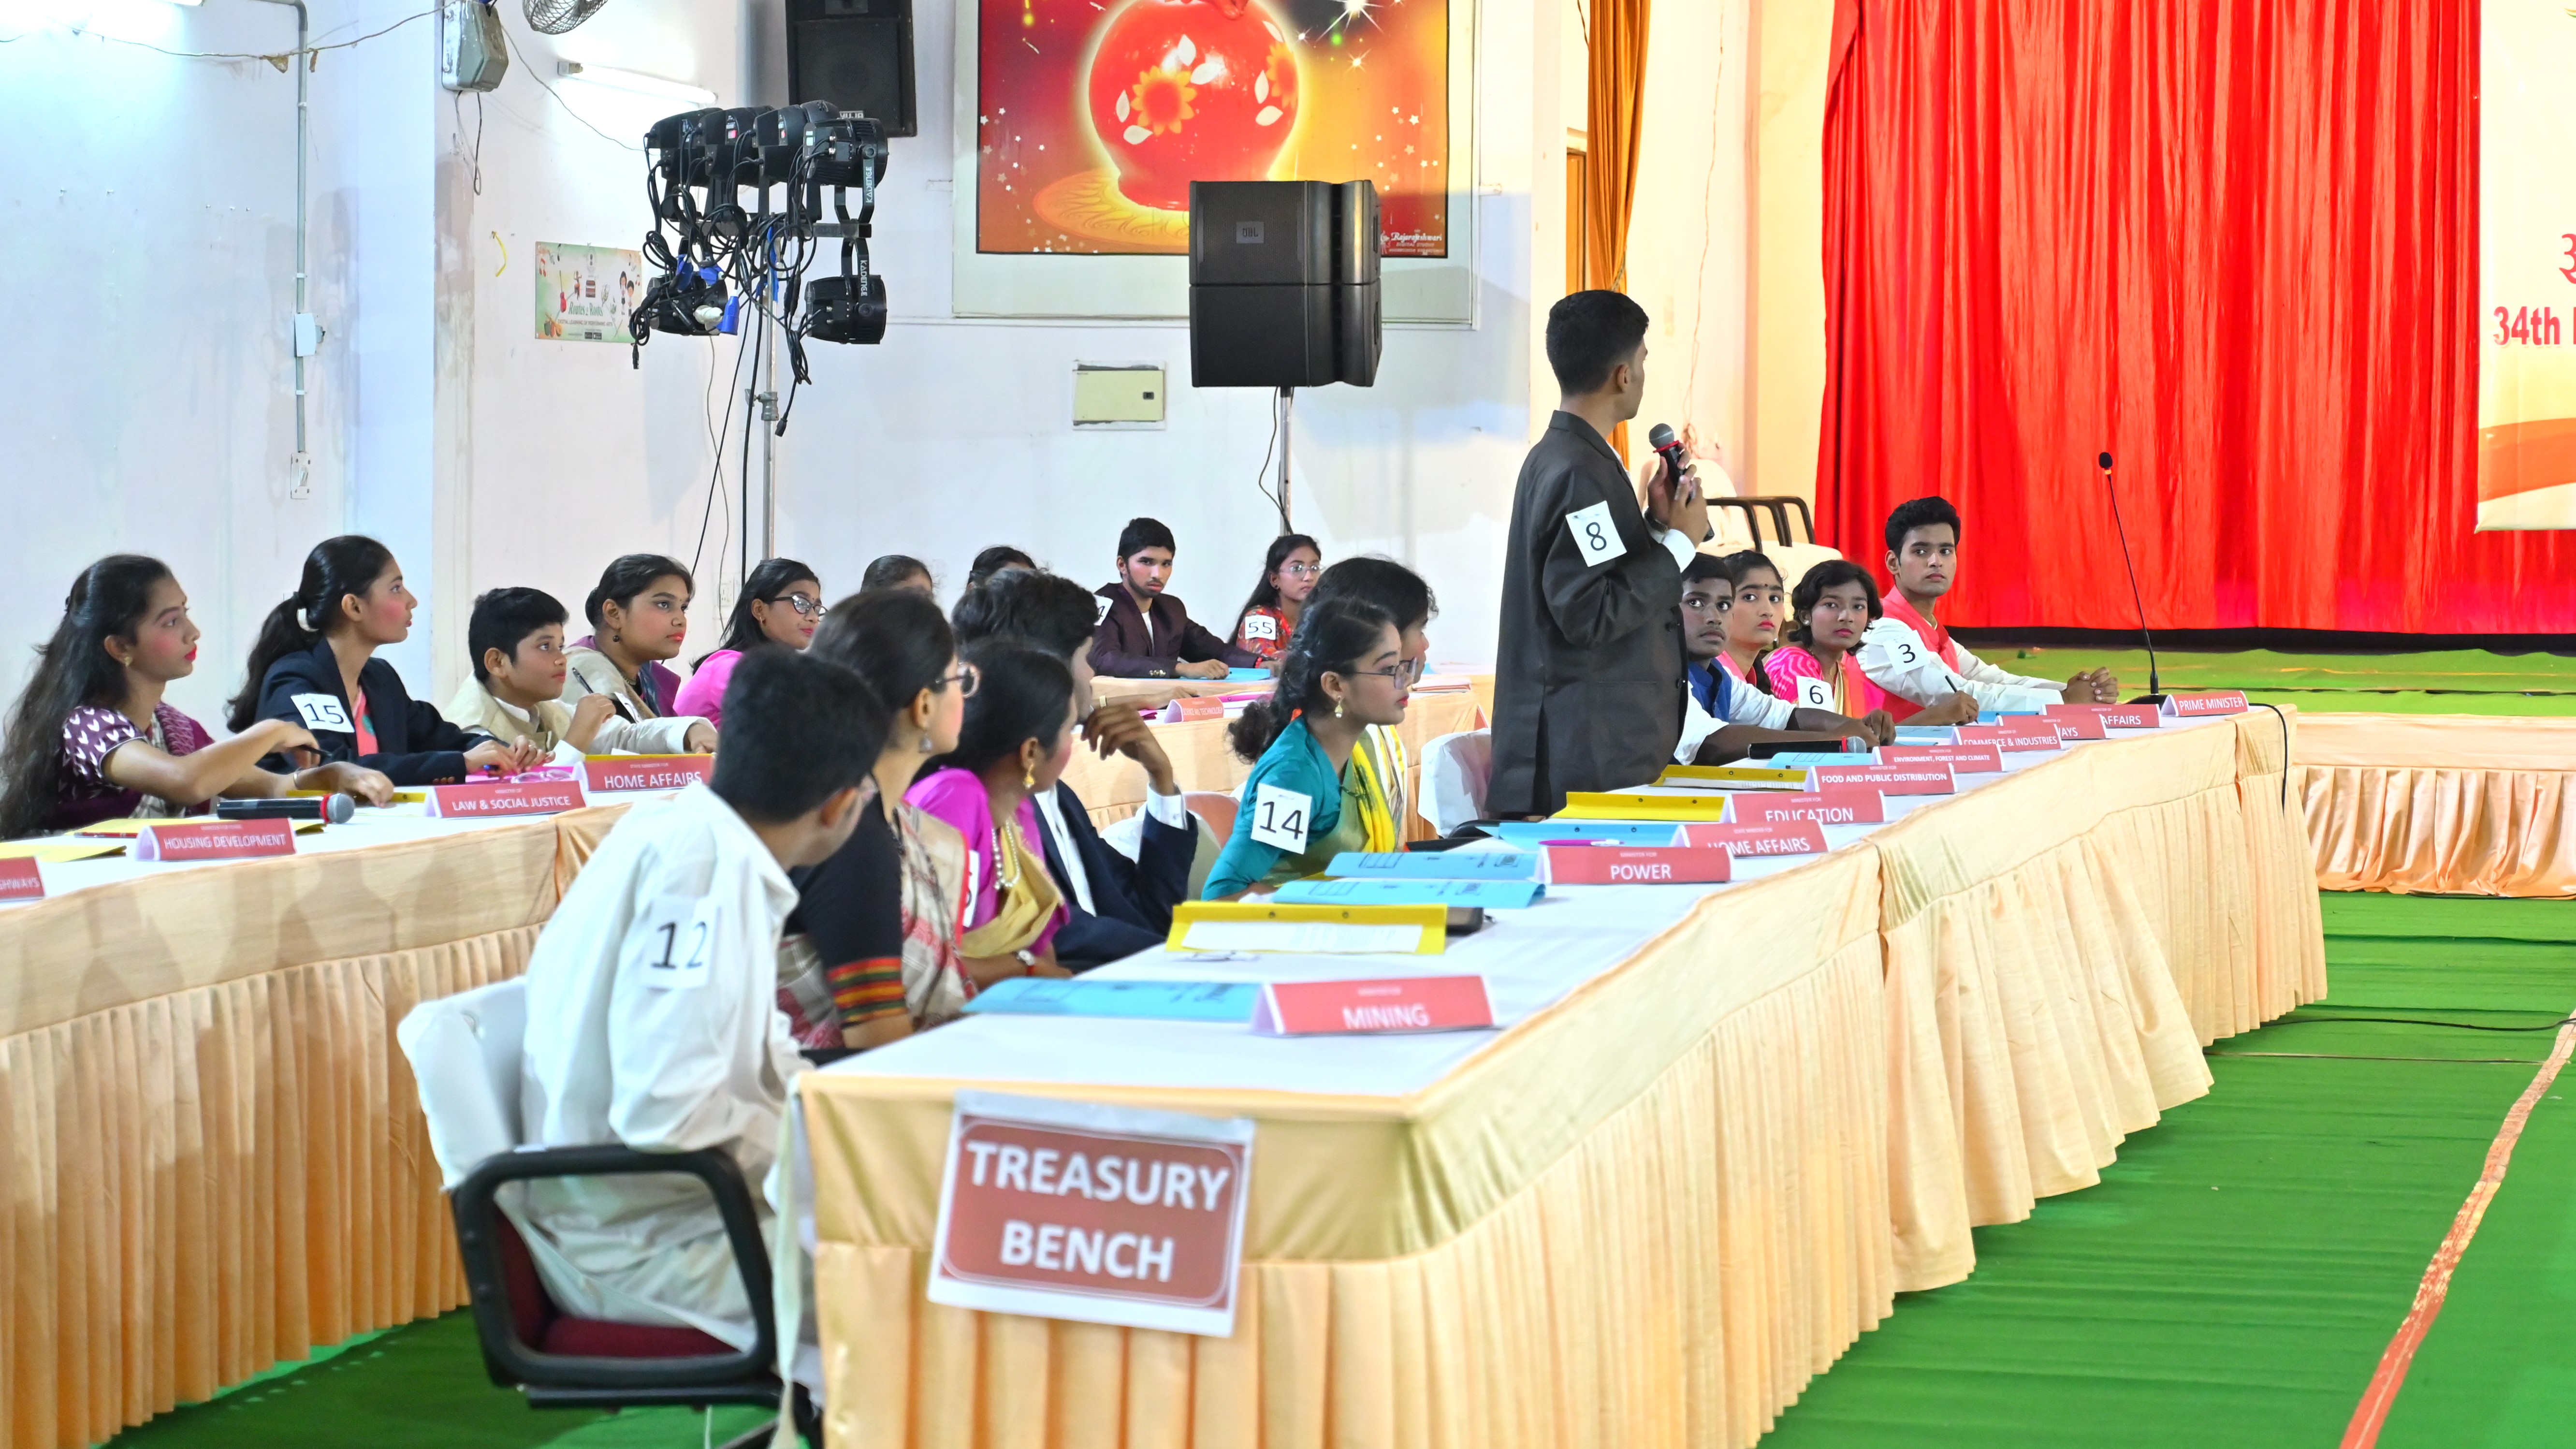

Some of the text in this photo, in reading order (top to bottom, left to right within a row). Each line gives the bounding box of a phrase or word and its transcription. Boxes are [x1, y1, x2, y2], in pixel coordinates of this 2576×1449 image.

[1242, 227, 1258, 237] JBL
[568, 301, 585, 315] Routes
[590, 303, 603, 316] Roots
[2493, 306, 2561, 345] 34th
[1586, 522, 1607, 551] 8
[1248, 621, 1273, 634] 55
[1898, 644, 1916, 663] 3
[1809, 685, 1823, 704] 6
[2179, 697, 2244, 711] PRIME MINISTER
[304, 703, 344, 724] 15
[2103, 716, 2141, 725] AFFAIRS
[1964, 736, 2057, 746] COMMERCE & INDUSTRIES
[604, 772, 701, 789] HOME AFFAIRS
[452, 796, 571, 811] LAW & SOCIAL JUSTICE
[1259, 801, 1304, 840] 14
[1765, 808, 1853, 822] EDUCATION
[163, 834, 287, 849] HOUSING DEVELOPMENT
[1756, 838, 1810, 853] AFFAIRS
[1611, 864, 1672, 879] POWER
[650, 921, 706, 970] 12
[1342, 1003, 1430, 1029] MINING
[966, 1140, 1229, 1212] TREASURY
[1001, 1219, 1175, 1283] BENCH
